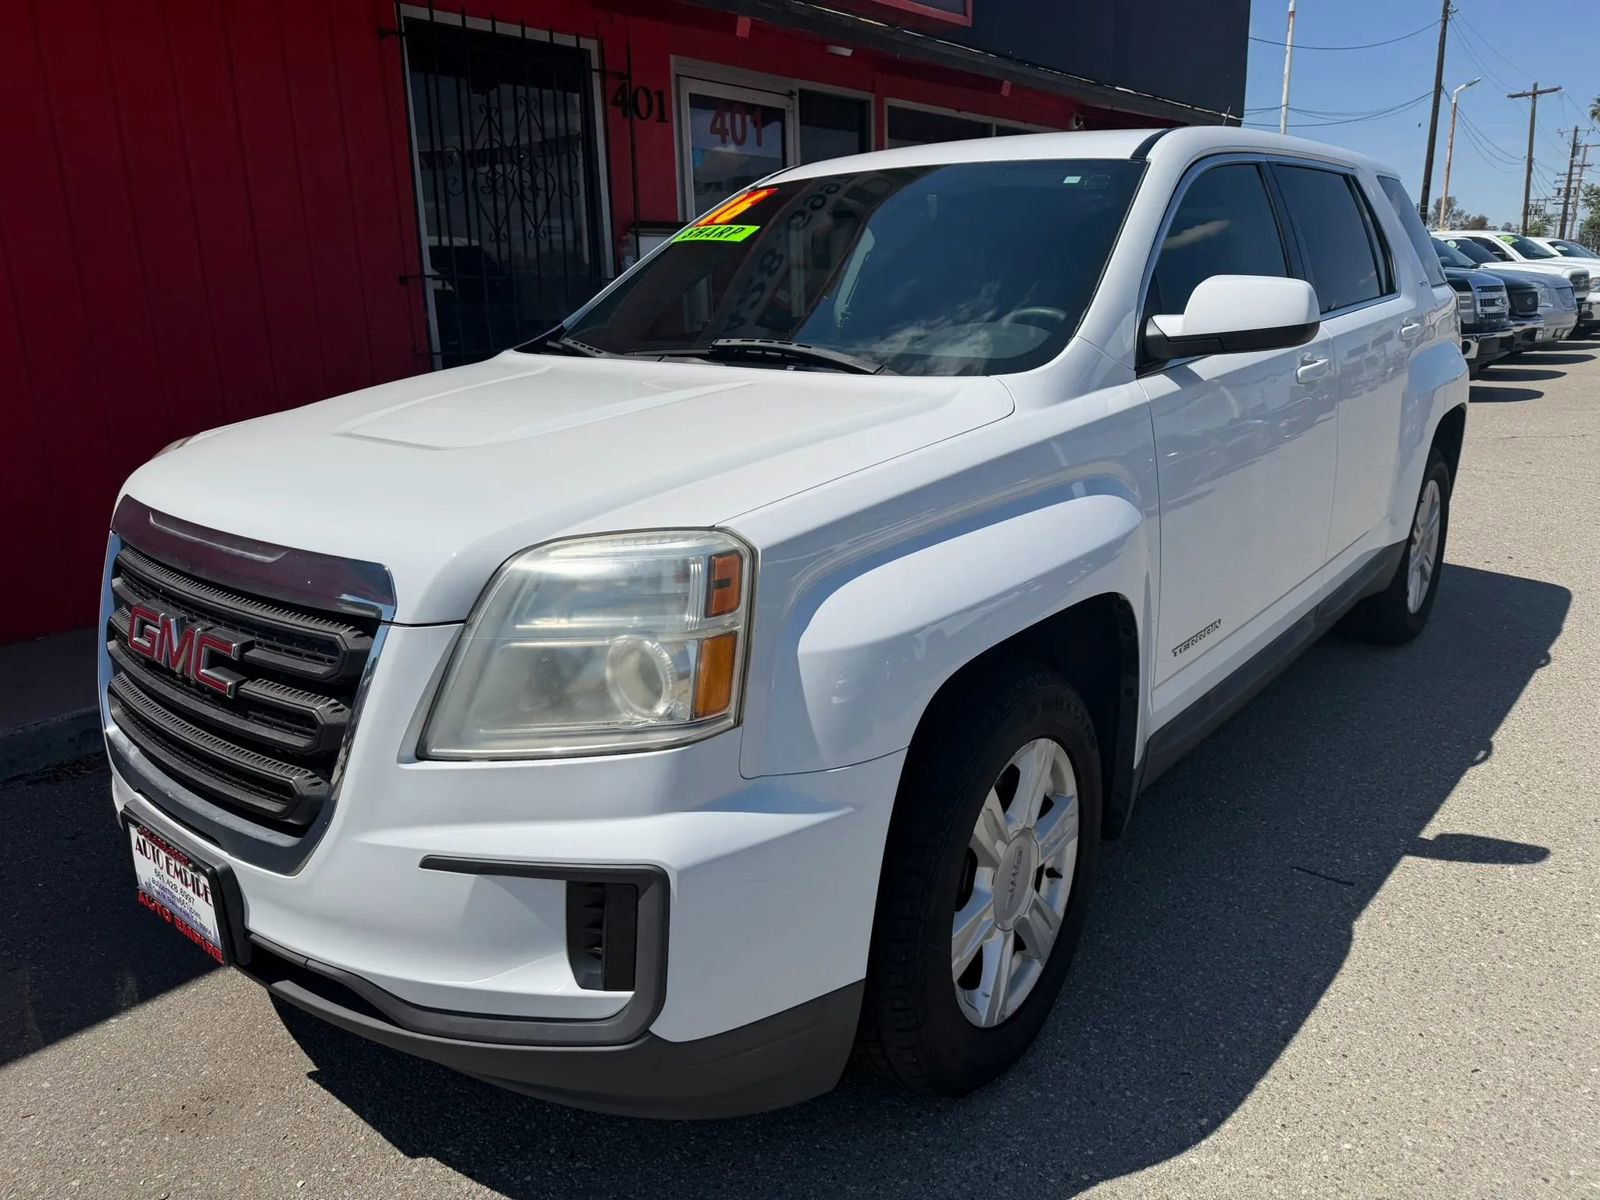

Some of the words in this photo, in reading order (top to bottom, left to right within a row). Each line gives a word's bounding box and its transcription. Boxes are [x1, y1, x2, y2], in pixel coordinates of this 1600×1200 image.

[612, 81, 671, 124] 401
[709, 105, 764, 148] 401
[681, 226, 746, 240] SHARP
[128, 606, 242, 699] GMC
[135, 836, 166, 871] AUTO
[165, 856, 213, 907] EMPIRE
[137, 890, 174, 924] AUTO
